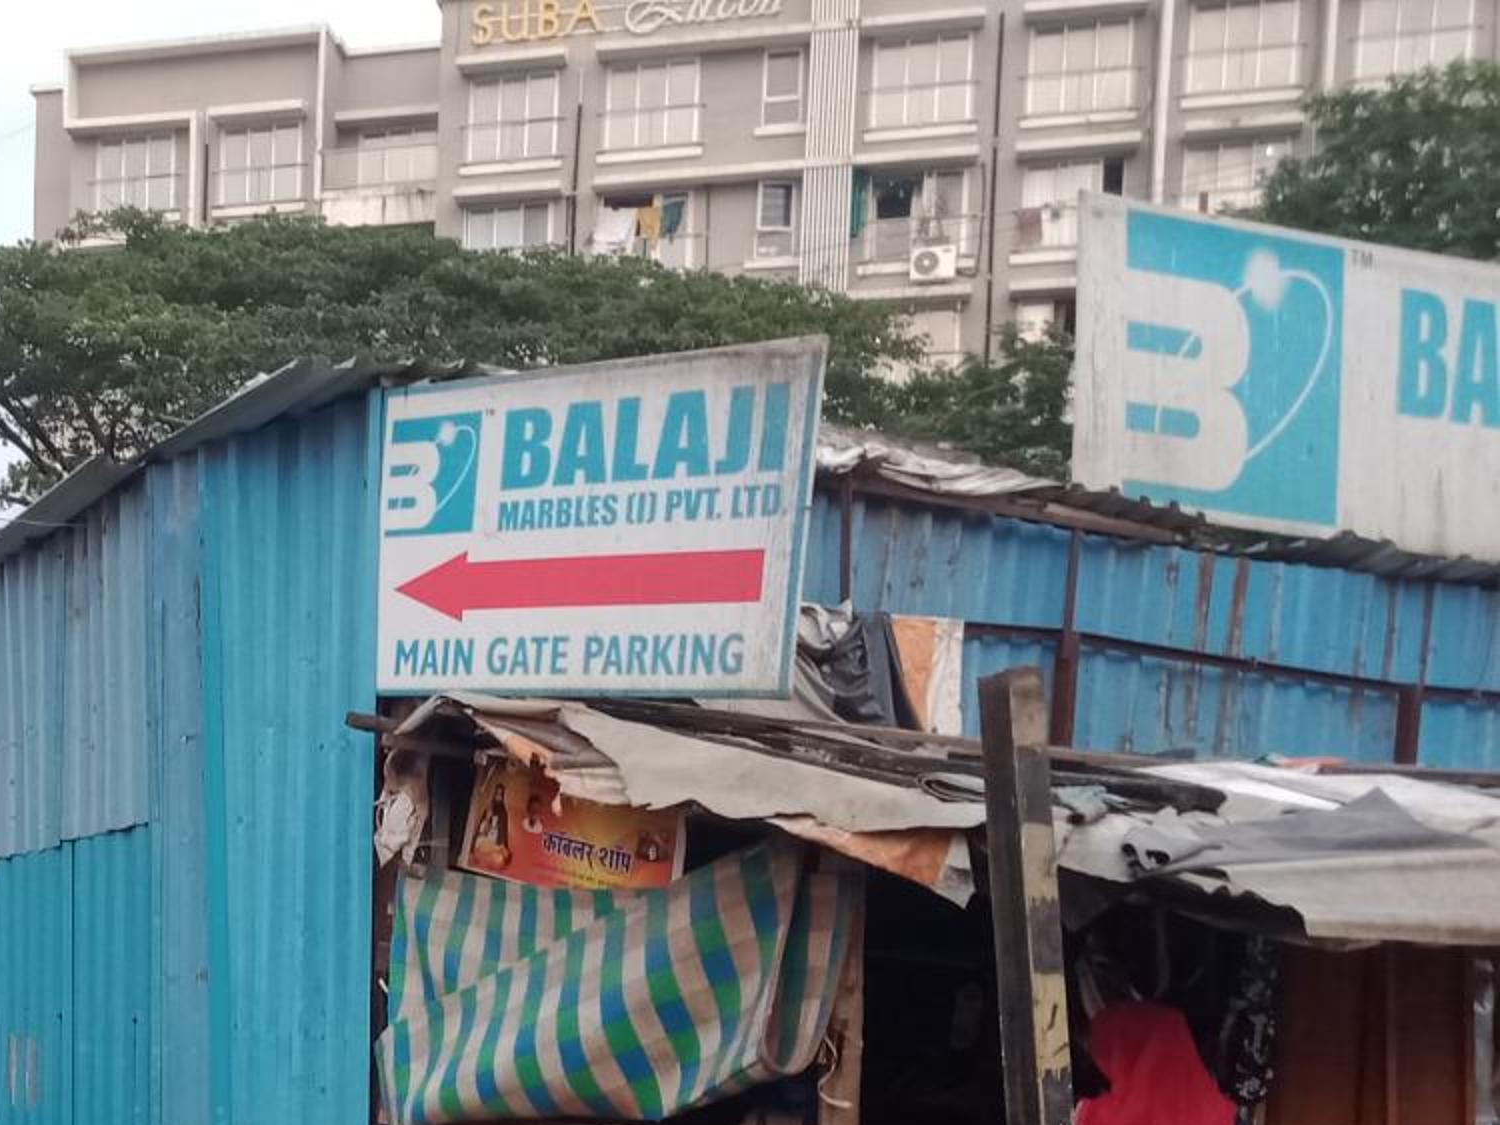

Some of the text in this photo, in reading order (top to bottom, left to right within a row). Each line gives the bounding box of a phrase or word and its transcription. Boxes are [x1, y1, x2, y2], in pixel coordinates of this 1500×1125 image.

[473, 0, 600, 44] SUBA
[1396, 287, 1500, 429] BA
[500, 383, 791, 490] BALAJI
[498, 494, 619, 532] MARBLES
[664, 487, 722, 523] PVT.
[393, 632, 746, 677] MAIN GATE PARKING
